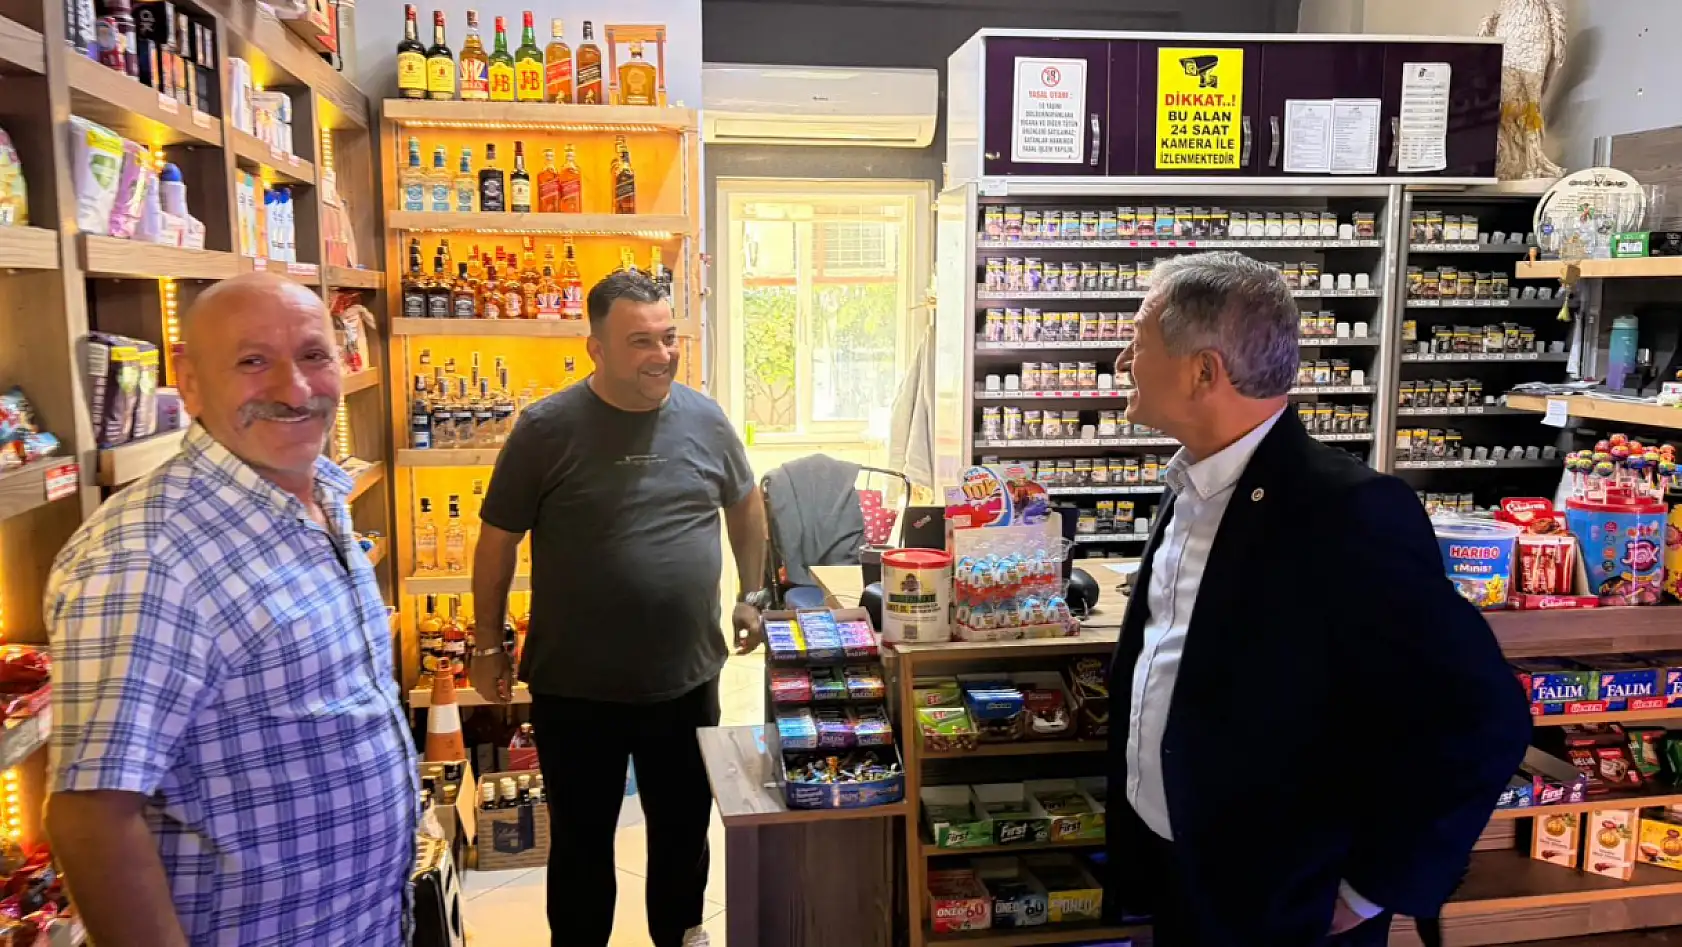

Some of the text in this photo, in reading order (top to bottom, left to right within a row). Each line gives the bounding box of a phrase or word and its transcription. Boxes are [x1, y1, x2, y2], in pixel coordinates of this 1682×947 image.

[1168, 111, 1231, 121] BU ALAN
[1171, 125, 1229, 135] 24 SAAT
[1161, 136, 1235, 149] KAMERA İLE
[1160, 151, 1235, 164] İZLENMEKTEDİR
[1451, 546, 1500, 560] HARIBO
[1459, 562, 1488, 573] Minis
[1539, 681, 1653, 700] FALIM FALIM
[1000, 822, 1028, 838] First
